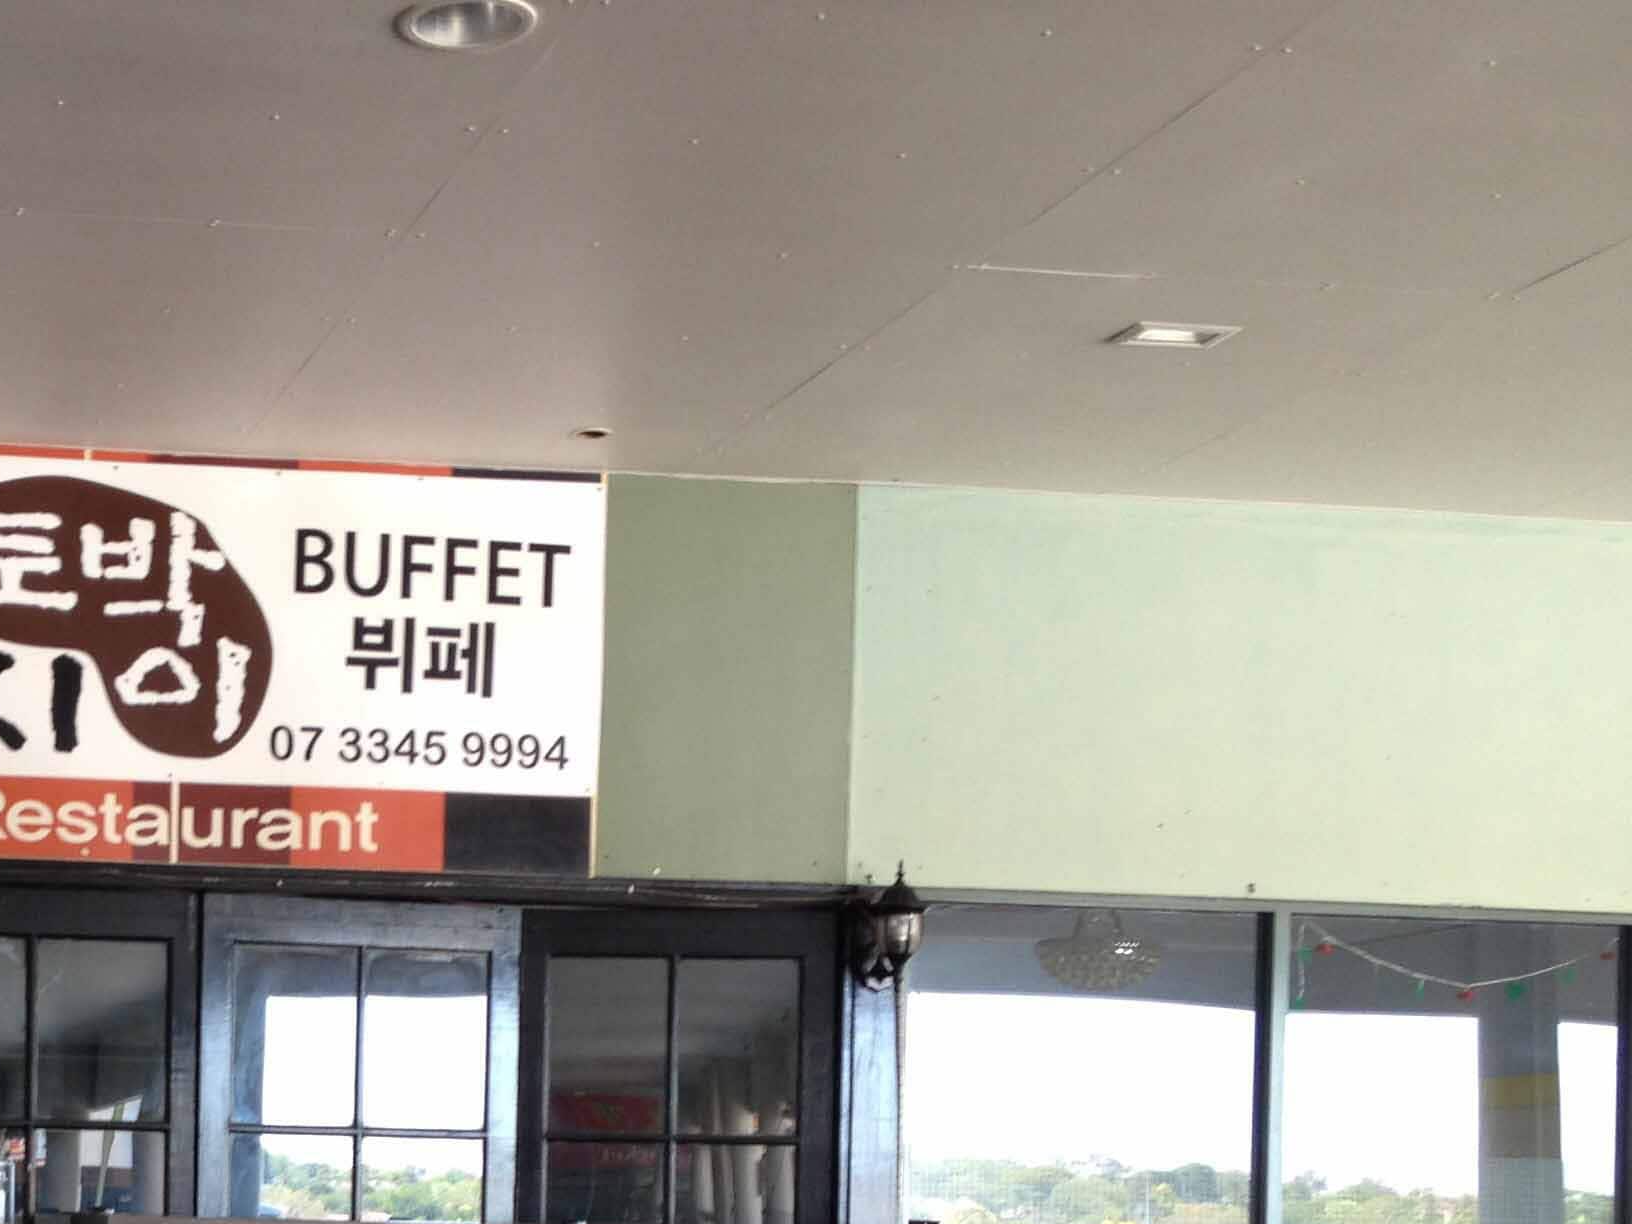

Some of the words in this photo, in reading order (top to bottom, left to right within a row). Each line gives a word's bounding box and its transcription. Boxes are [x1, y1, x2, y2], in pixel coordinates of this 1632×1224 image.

[294, 528, 572, 608] BUFFET
[345, 616, 495, 699] 뷔페
[270, 725, 324, 761] 07
[338, 727, 448, 766] 3345
[461, 731, 569, 770] 9994
